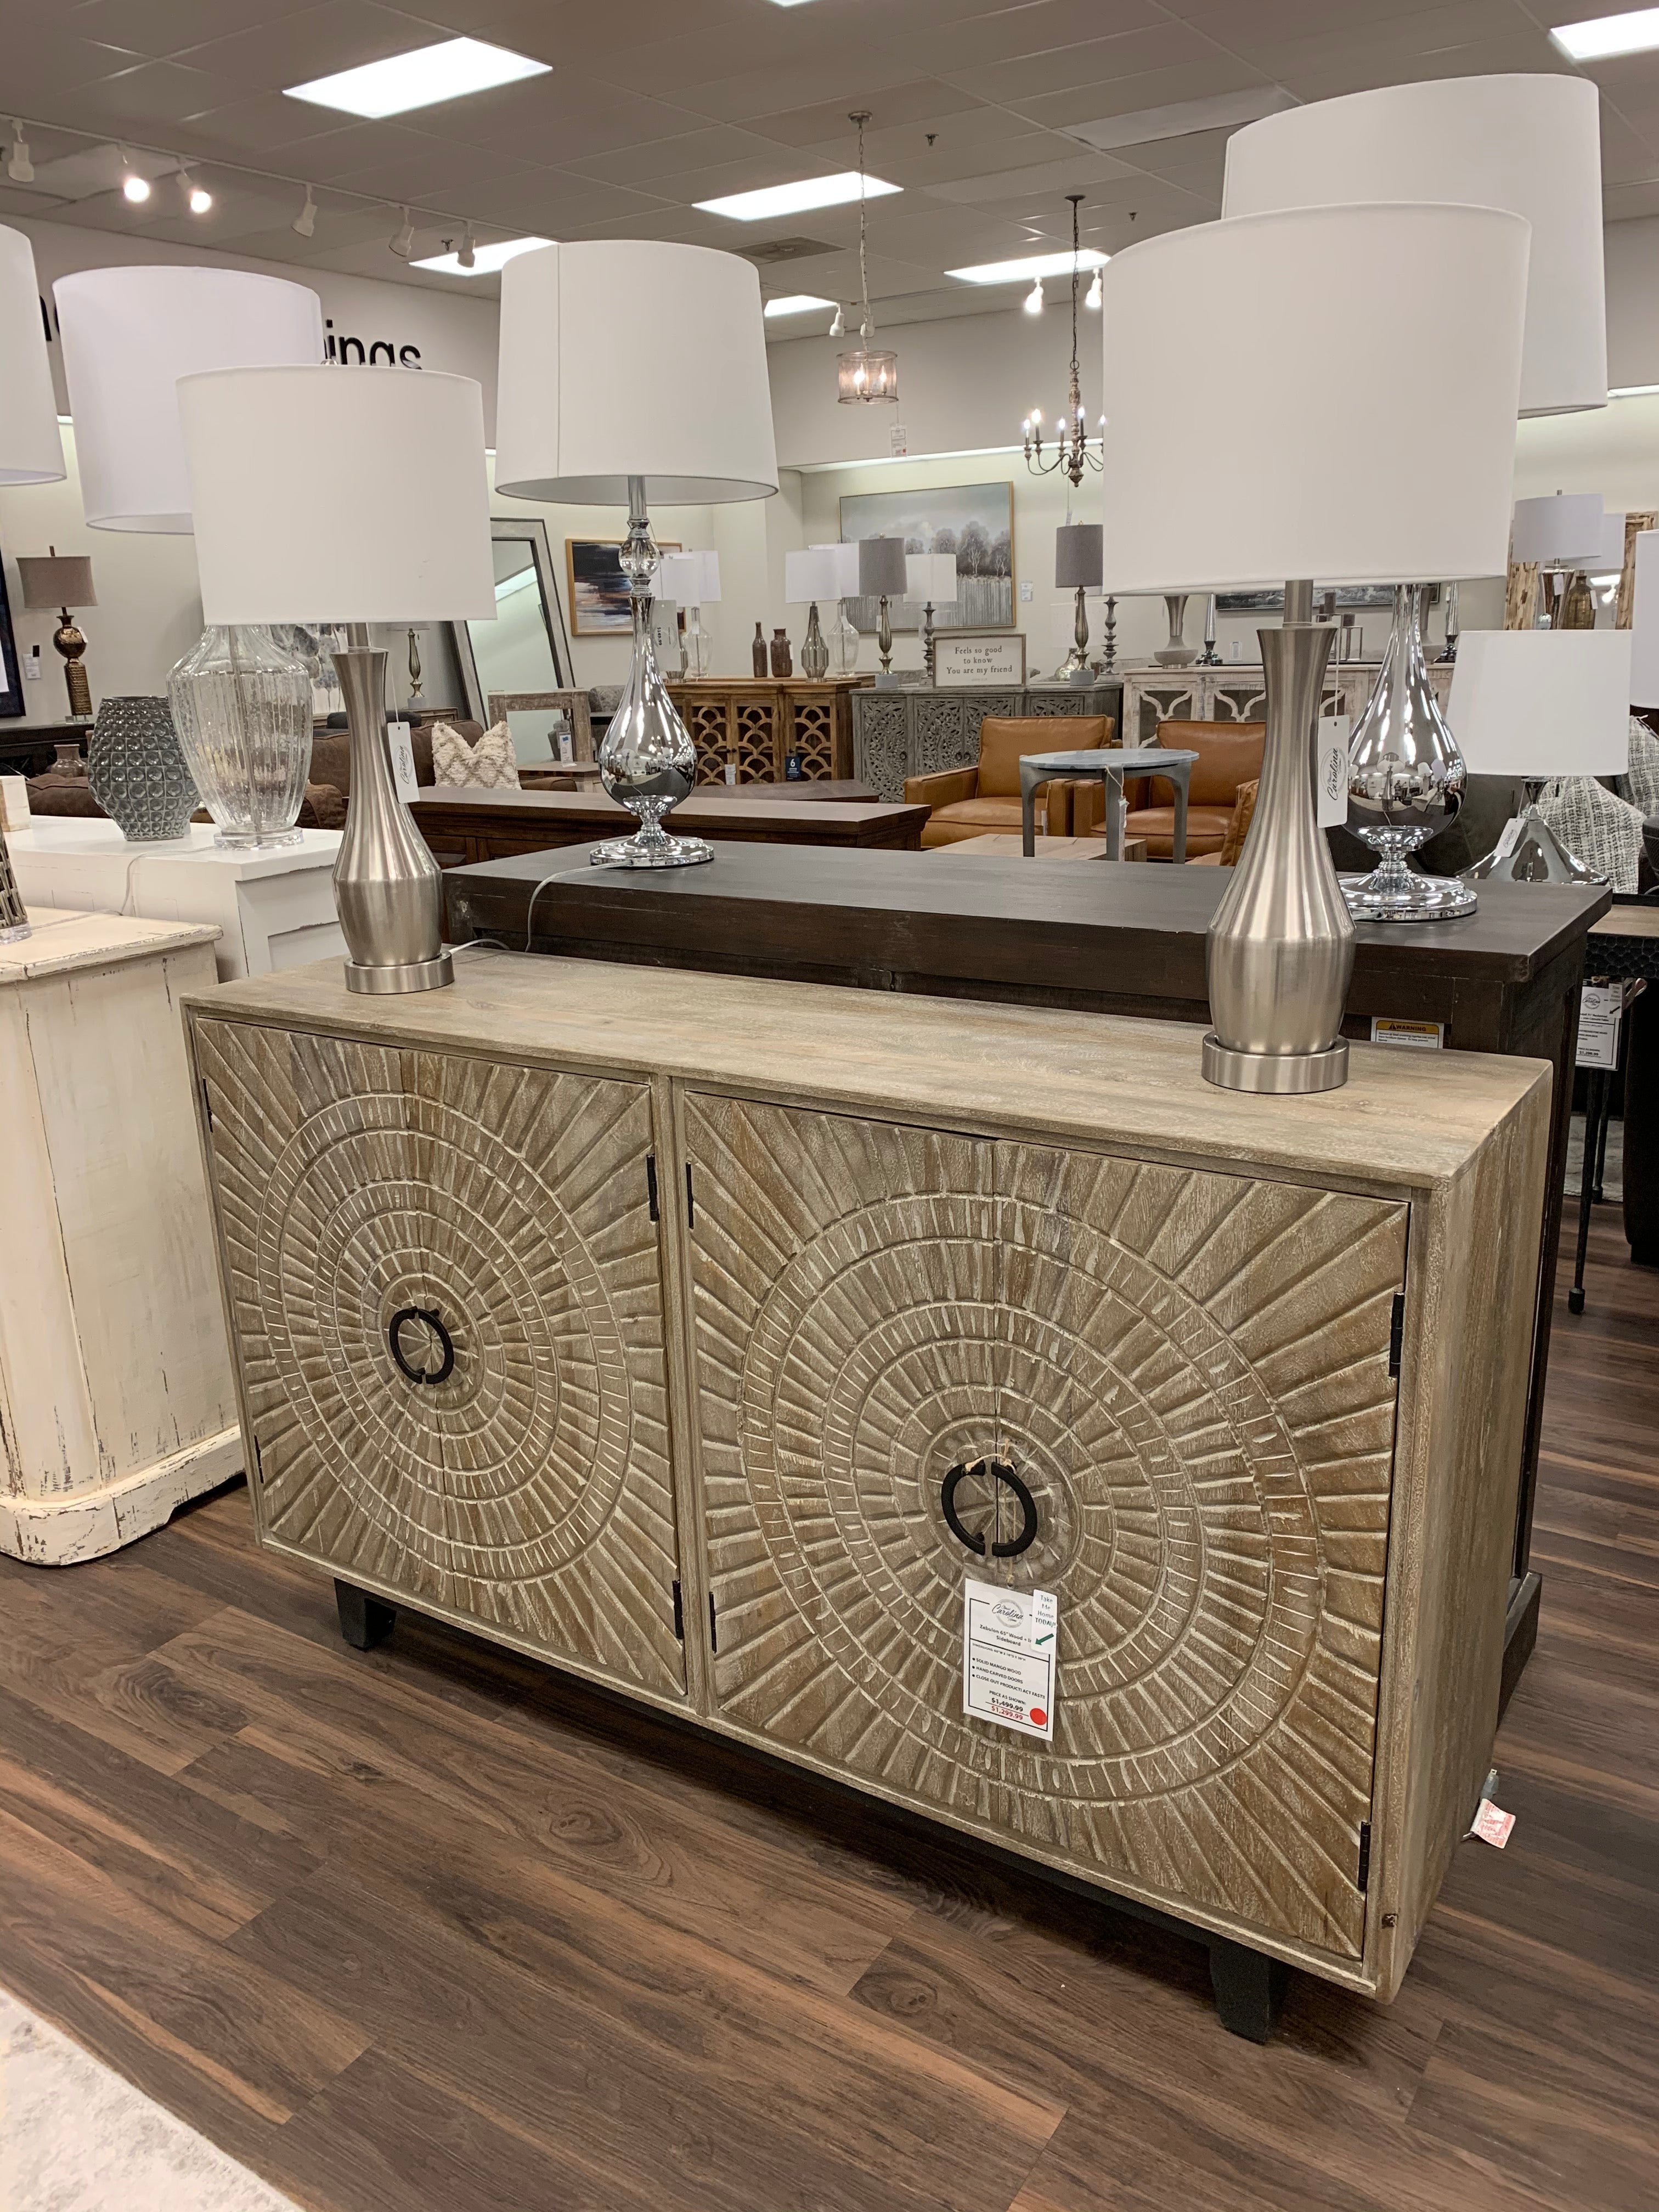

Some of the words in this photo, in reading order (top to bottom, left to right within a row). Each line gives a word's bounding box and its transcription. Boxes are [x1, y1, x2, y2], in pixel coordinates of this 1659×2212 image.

[985, 645, 1002, 656] good
[991, 664, 1012, 673] friend
[790, 758, 795, 767] 6
[1327, 748, 1338, 800] Carolina
[992, 1604, 1024, 1620] Carolina
[1037, 1610, 1054, 1618] Home
[979, 1624, 999, 1634] Zebulon
[1009, 1633, 1023, 1641] Wood
[996, 1635, 1021, 1646] Sideboard
[990, 1661, 1007, 1671] MANGO
[990, 1670, 1007, 1679] CARVED
[991, 1697, 1023, 1712] $1,499.99
[991, 1706, 1023, 1720] $1,299.99
